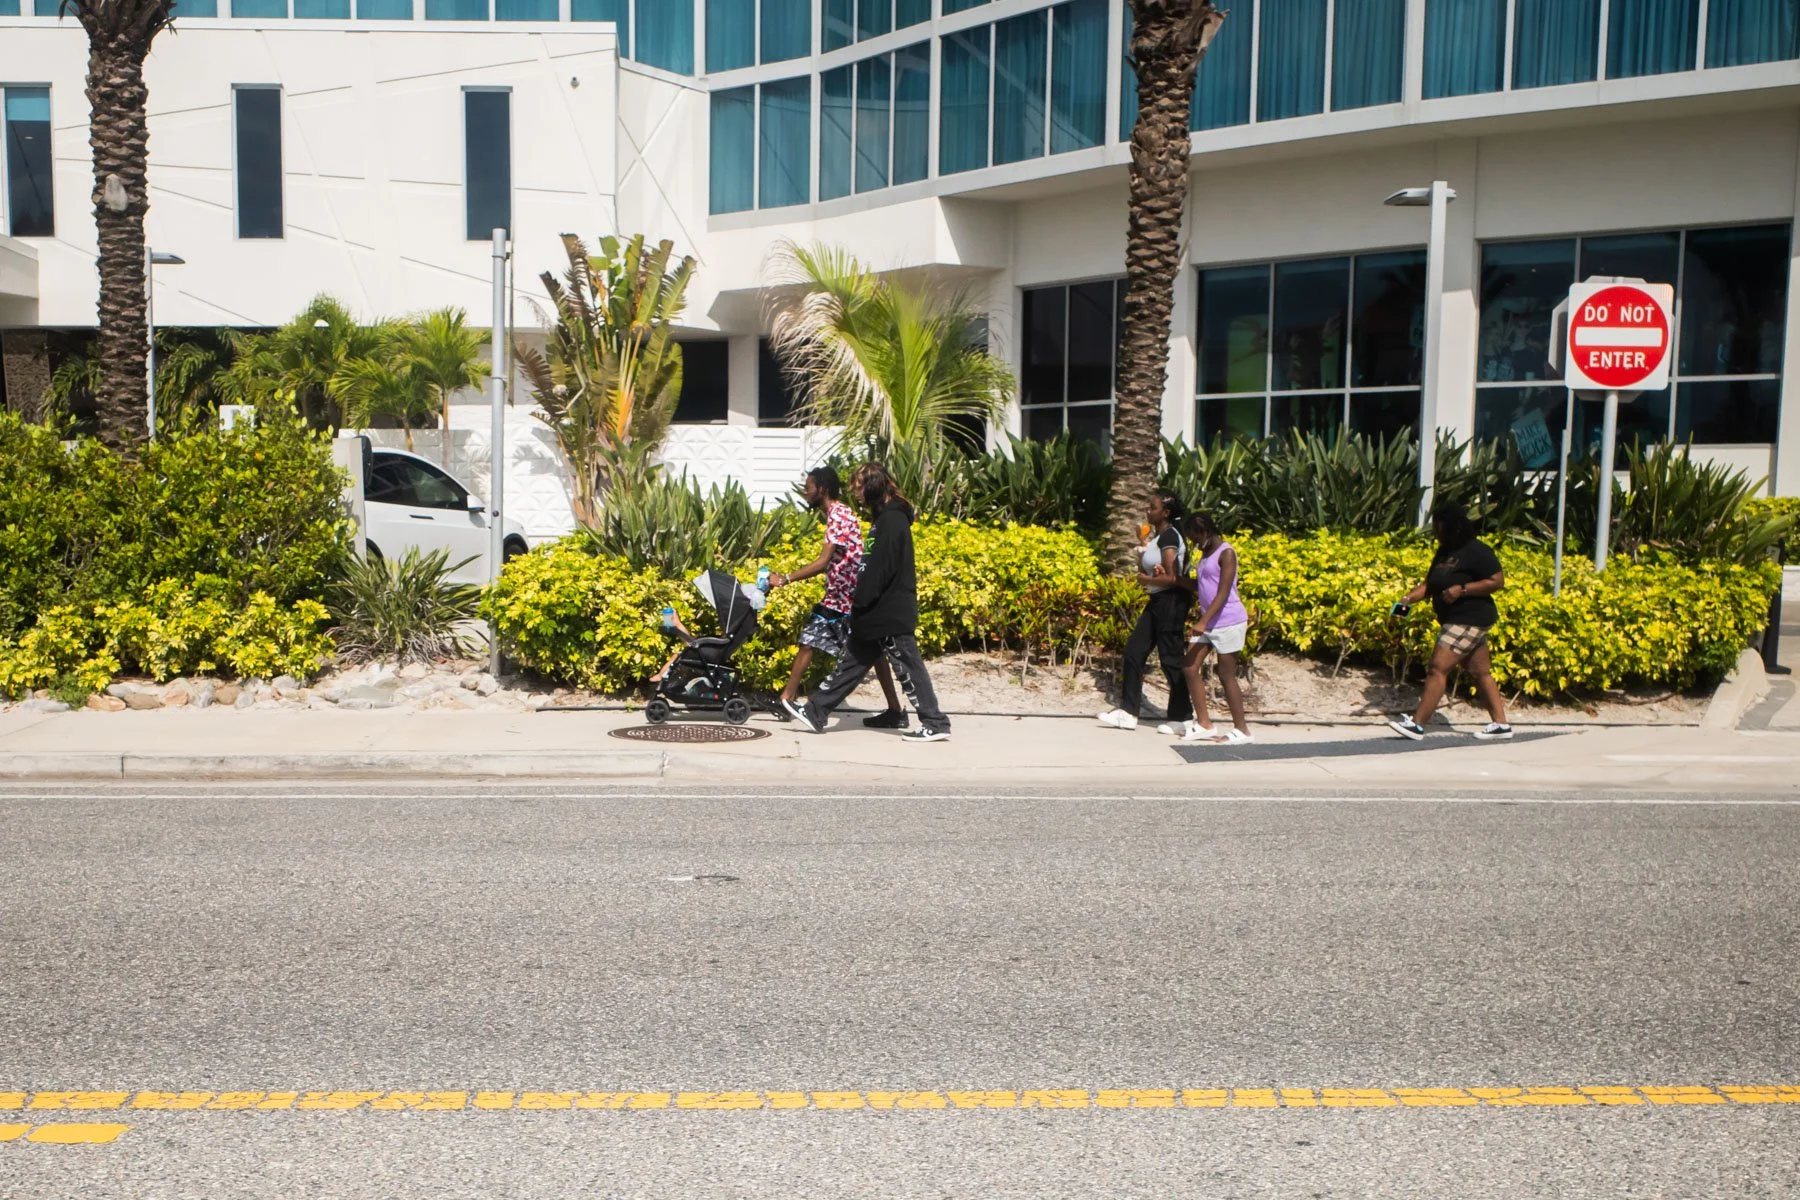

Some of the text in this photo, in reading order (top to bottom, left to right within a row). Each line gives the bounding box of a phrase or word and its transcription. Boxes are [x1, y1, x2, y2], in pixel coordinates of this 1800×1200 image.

[1584, 305, 1655, 323] DO NOT
[1589, 351, 1646, 368] ENTER
